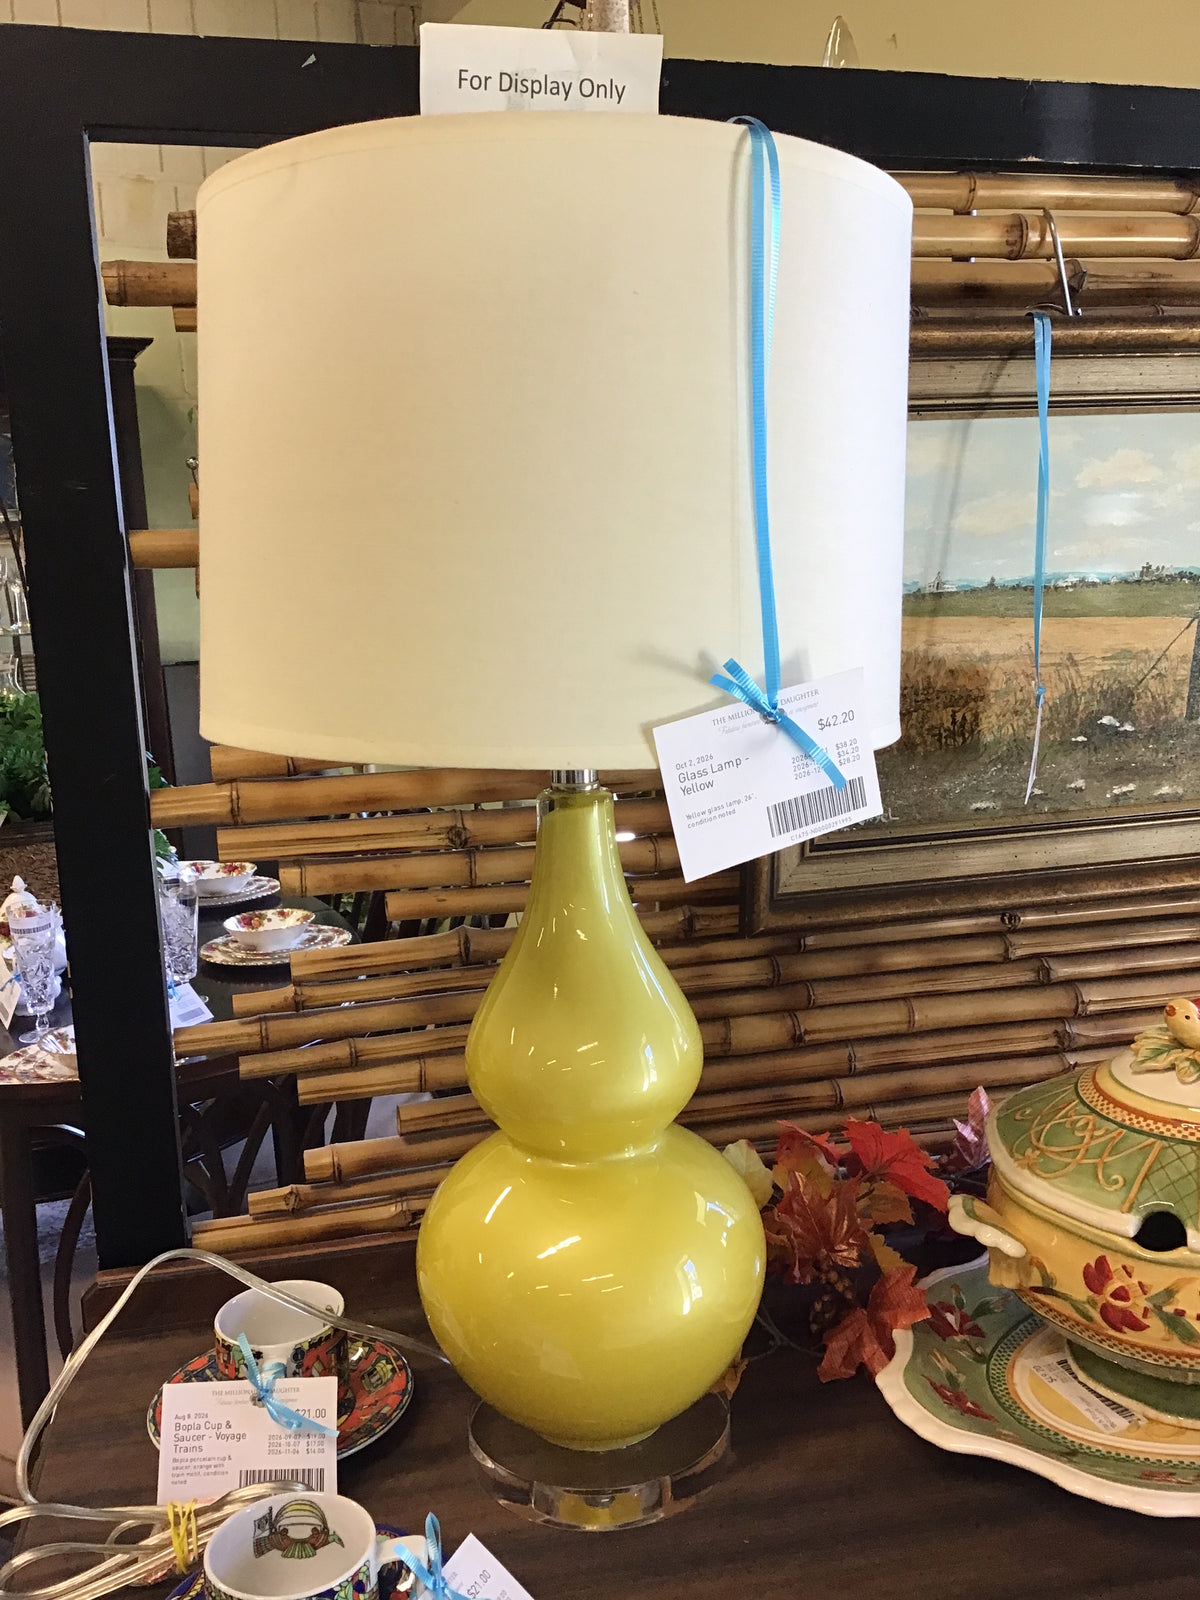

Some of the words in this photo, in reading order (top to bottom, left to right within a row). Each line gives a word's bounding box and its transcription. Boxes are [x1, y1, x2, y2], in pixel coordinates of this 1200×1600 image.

[458, 69, 492, 91] For
[499, 72, 573, 101] Display
[579, 78, 626, 104] Only
[712, 717, 726, 726] THE
[780, 688, 820, 706] DAUGHTER
[817, 709, 856, 731] $42.20
[675, 761, 687, 771] Oct
[688, 759, 696, 767] 2,
[696, 753, 714, 765] 2026
[678, 767, 709, 784] Glass
[710, 757, 742, 774] Lamp
[794, 766, 821, 780] 2026-12
[680, 779, 714, 797] Yellow
[685, 808, 706, 820] Yellow
[707, 804, 725, 815] glass
[687, 814, 718, 829] condition
[718, 808, 736, 819] noted
[174, 1422, 202, 1432] Bopla
[204, 1420, 223, 1431] Cup
[225, 1420, 232, 1430] &
[173, 1433, 206, 1443] Saucer
[215, 1431, 247, 1443] Voyage
[173, 1443, 204, 1454] Trains
[467, 1569, 491, 1600] $21.00
